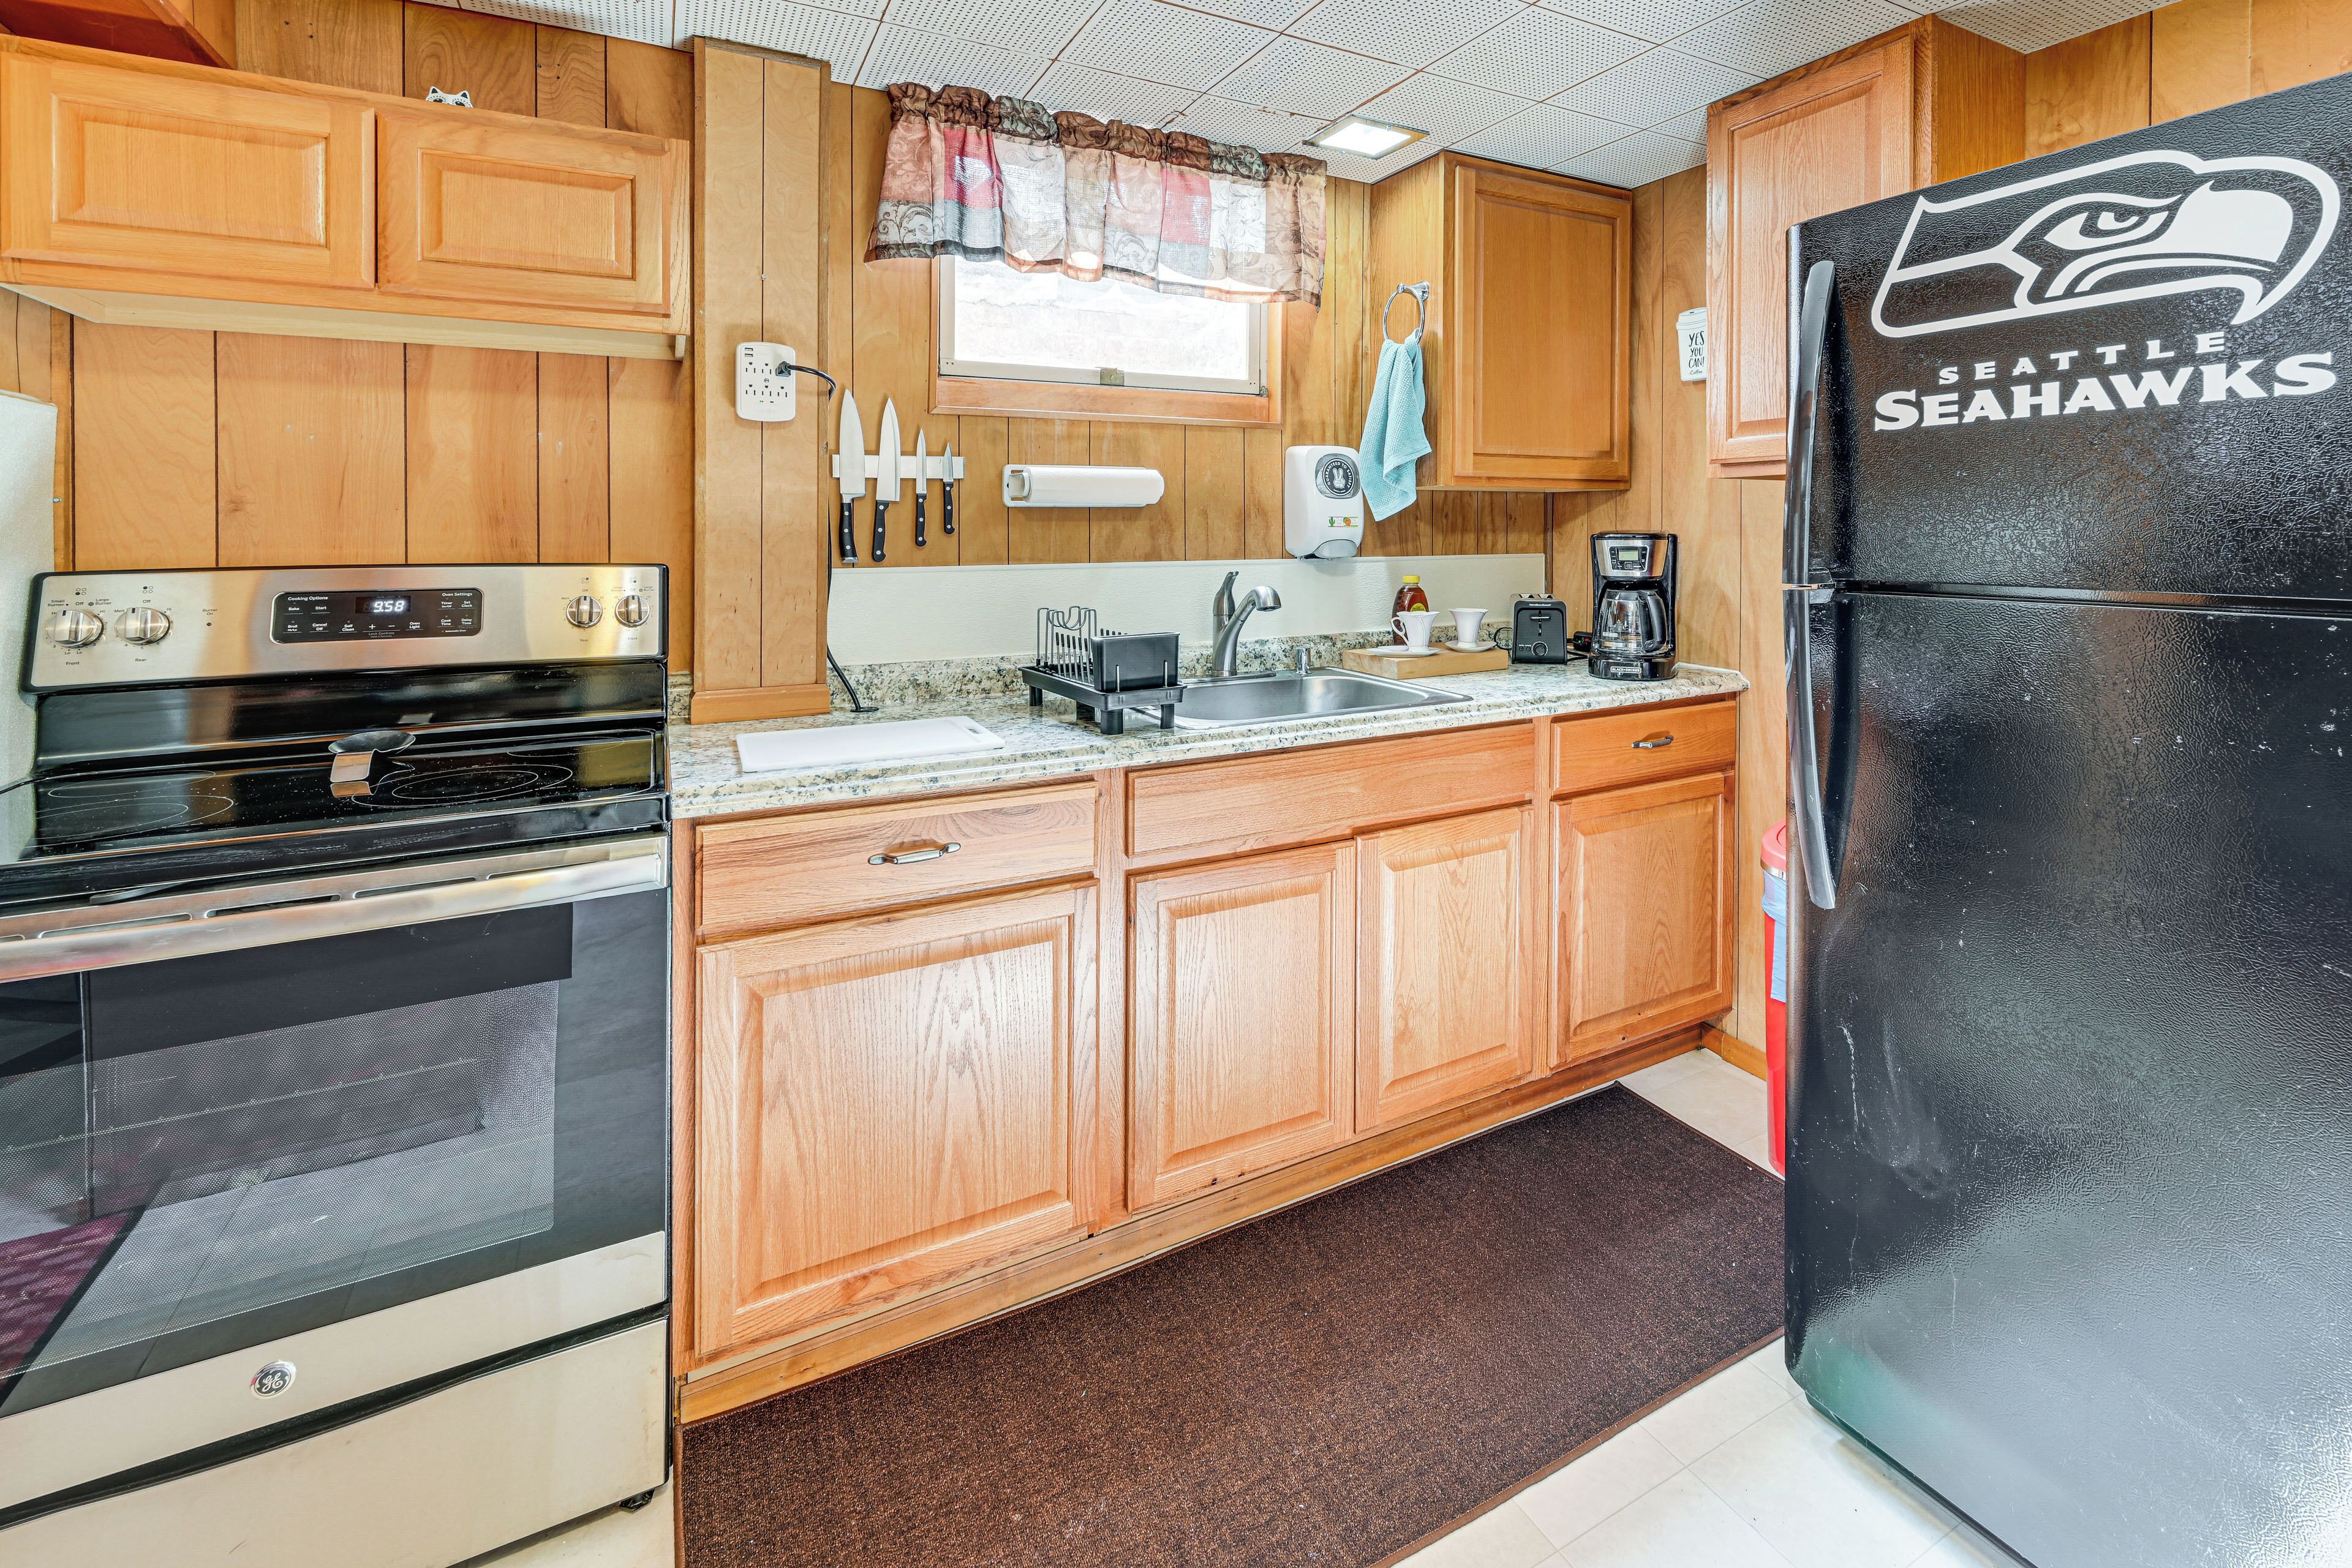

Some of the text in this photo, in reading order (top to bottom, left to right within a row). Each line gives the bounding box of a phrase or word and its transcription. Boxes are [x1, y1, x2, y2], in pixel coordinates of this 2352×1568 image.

[1689, 331, 1705, 347] YES
[1689, 356, 1705, 368] CAN!
[1690, 347, 1703, 357] YOU
[1938, 331, 2225, 385] SEATTLE
[1874, 352, 2337, 432] SEAHAWKS
[1325, 461, 1341, 486] GUARANTEED
